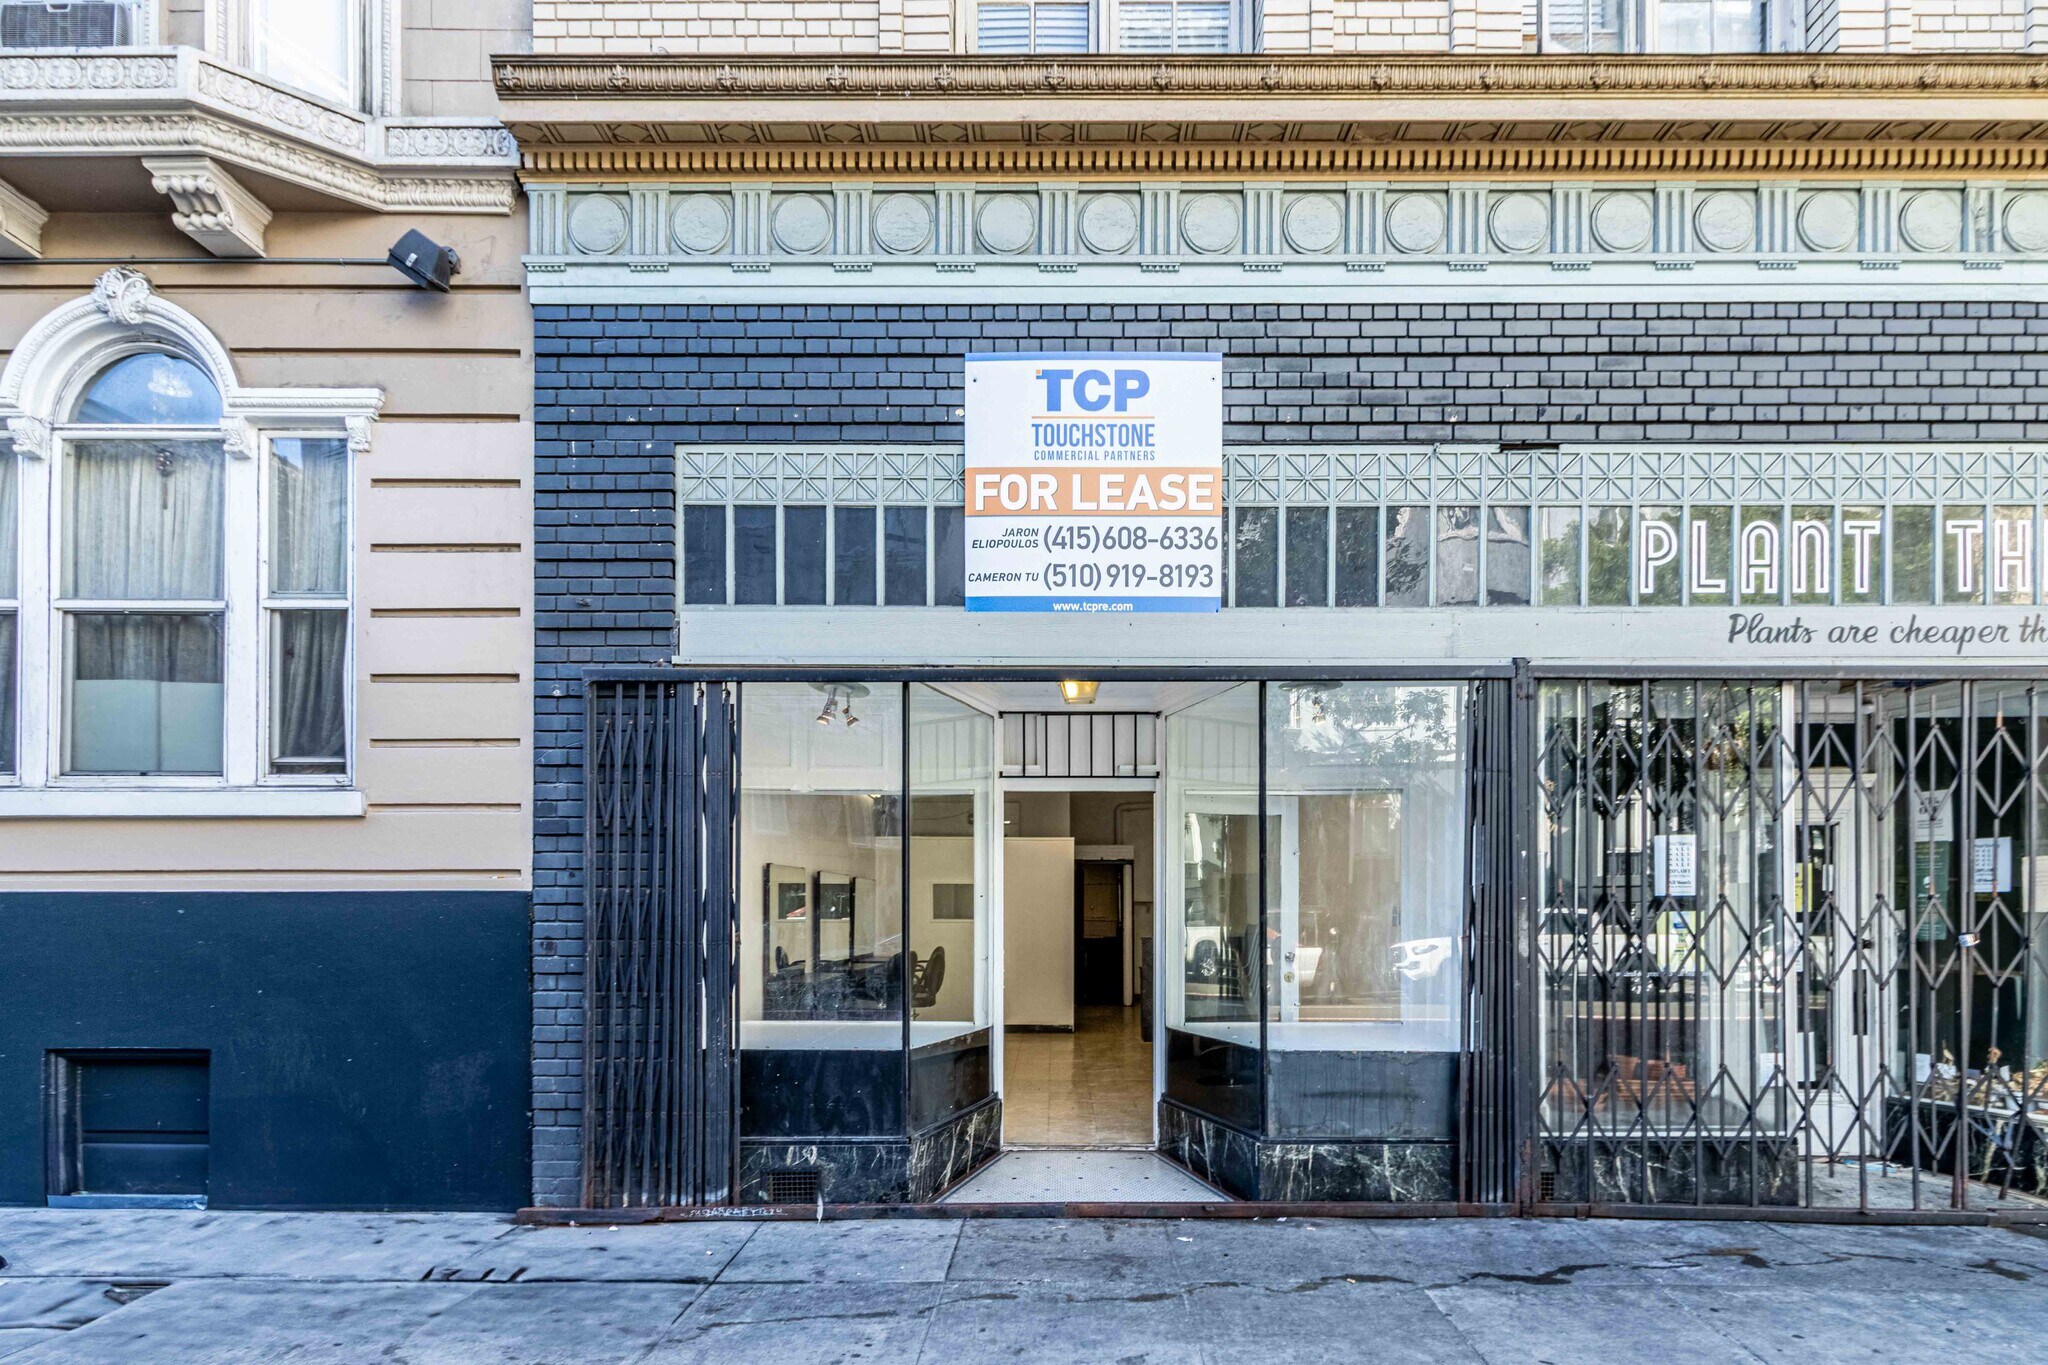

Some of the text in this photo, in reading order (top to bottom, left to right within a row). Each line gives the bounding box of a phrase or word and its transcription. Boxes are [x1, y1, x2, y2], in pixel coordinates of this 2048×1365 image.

[1036, 369, 1150, 412] TCP
[1031, 423, 1155, 447] TOUCHSTONE
[1034, 450, 1155, 461] COMMERCIAL PARTNERS
[975, 473, 1215, 512] FOR LEASE
[1002, 528, 1039, 537] JARON
[972, 539, 1039, 549] ELIOPOULOS
[1640, 519, 2048, 594] PLANT TH
[968, 572, 1022, 582] CAMERON
[1025, 572, 1039, 582] TU
[1053, 602, 1133, 613] www.tcpre.com
[1728, 613, 1818, 644] Plants
[1828, 625, 1878, 644] are
[1890, 613, 2010, 655] cheaper
